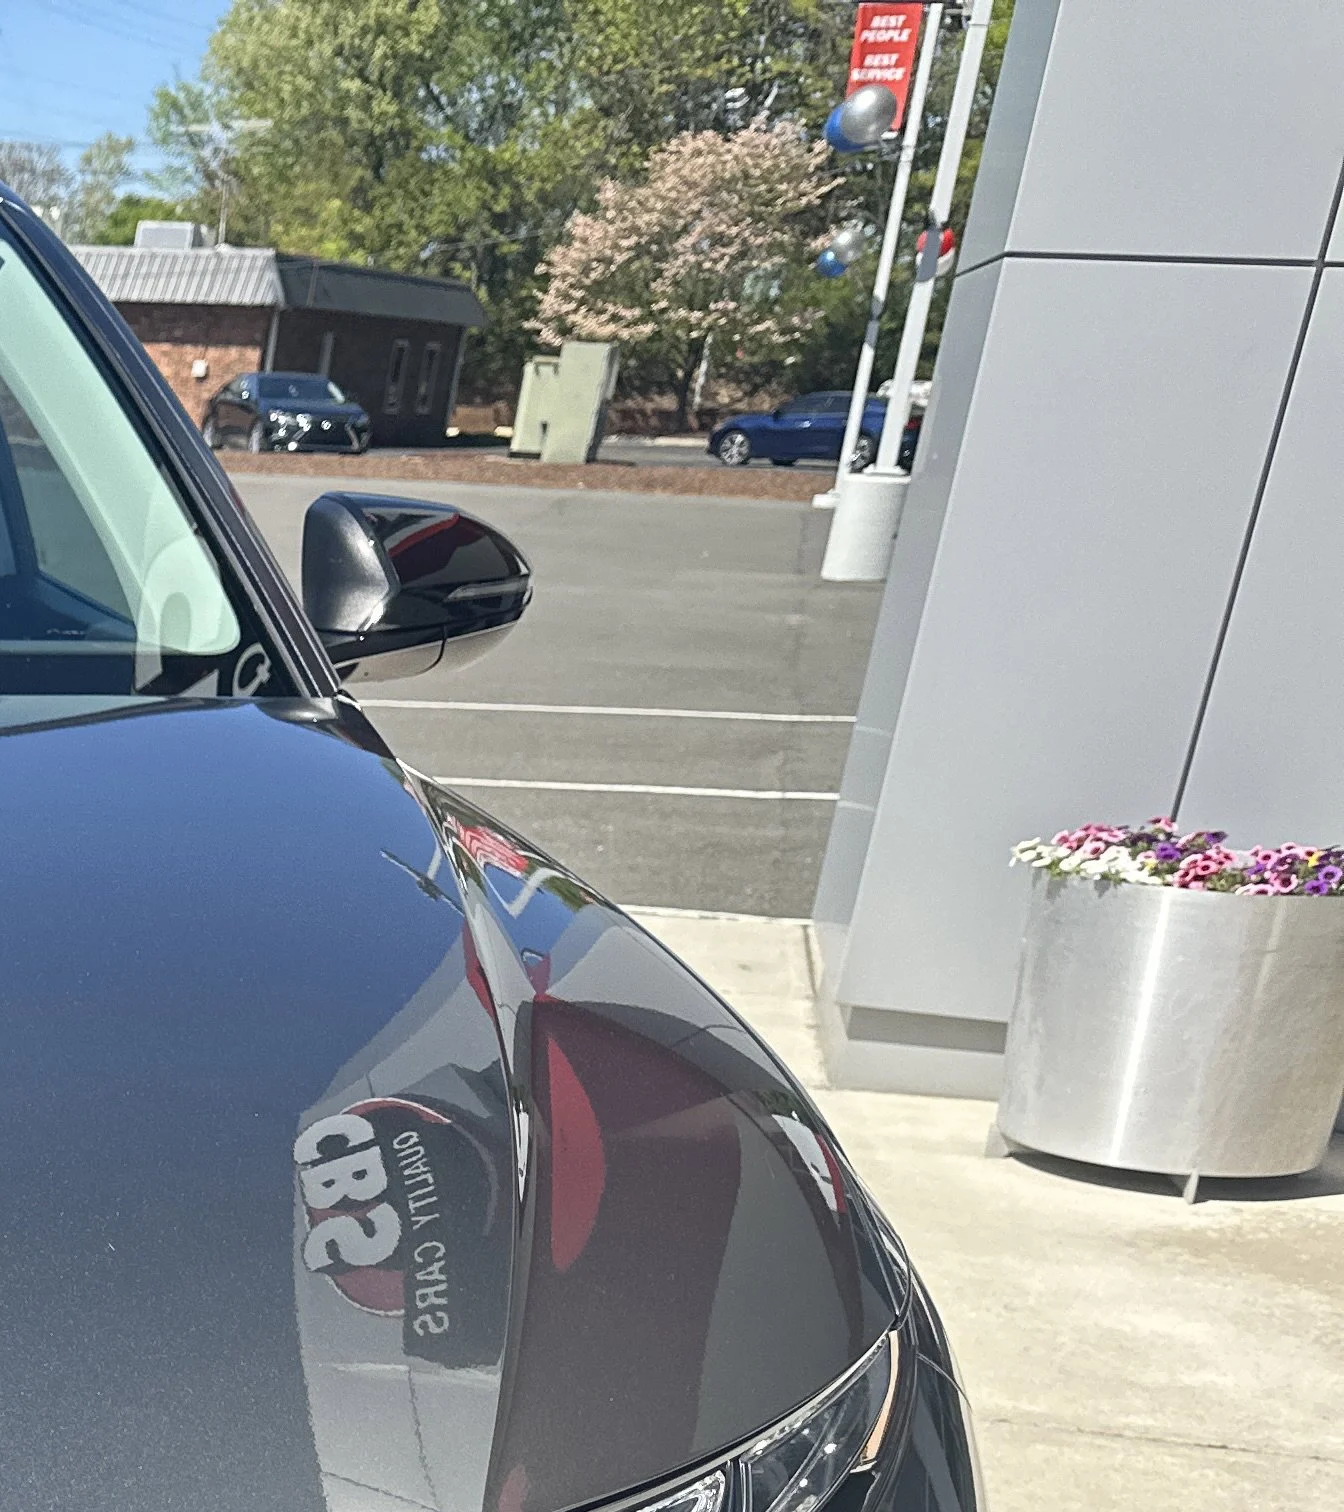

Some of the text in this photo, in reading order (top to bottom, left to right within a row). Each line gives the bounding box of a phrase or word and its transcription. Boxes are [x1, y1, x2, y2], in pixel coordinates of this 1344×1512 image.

[870, 15, 907, 28] BEST
[860, 28, 912, 43] PEOPLE
[863, 53, 900, 67] BEST
